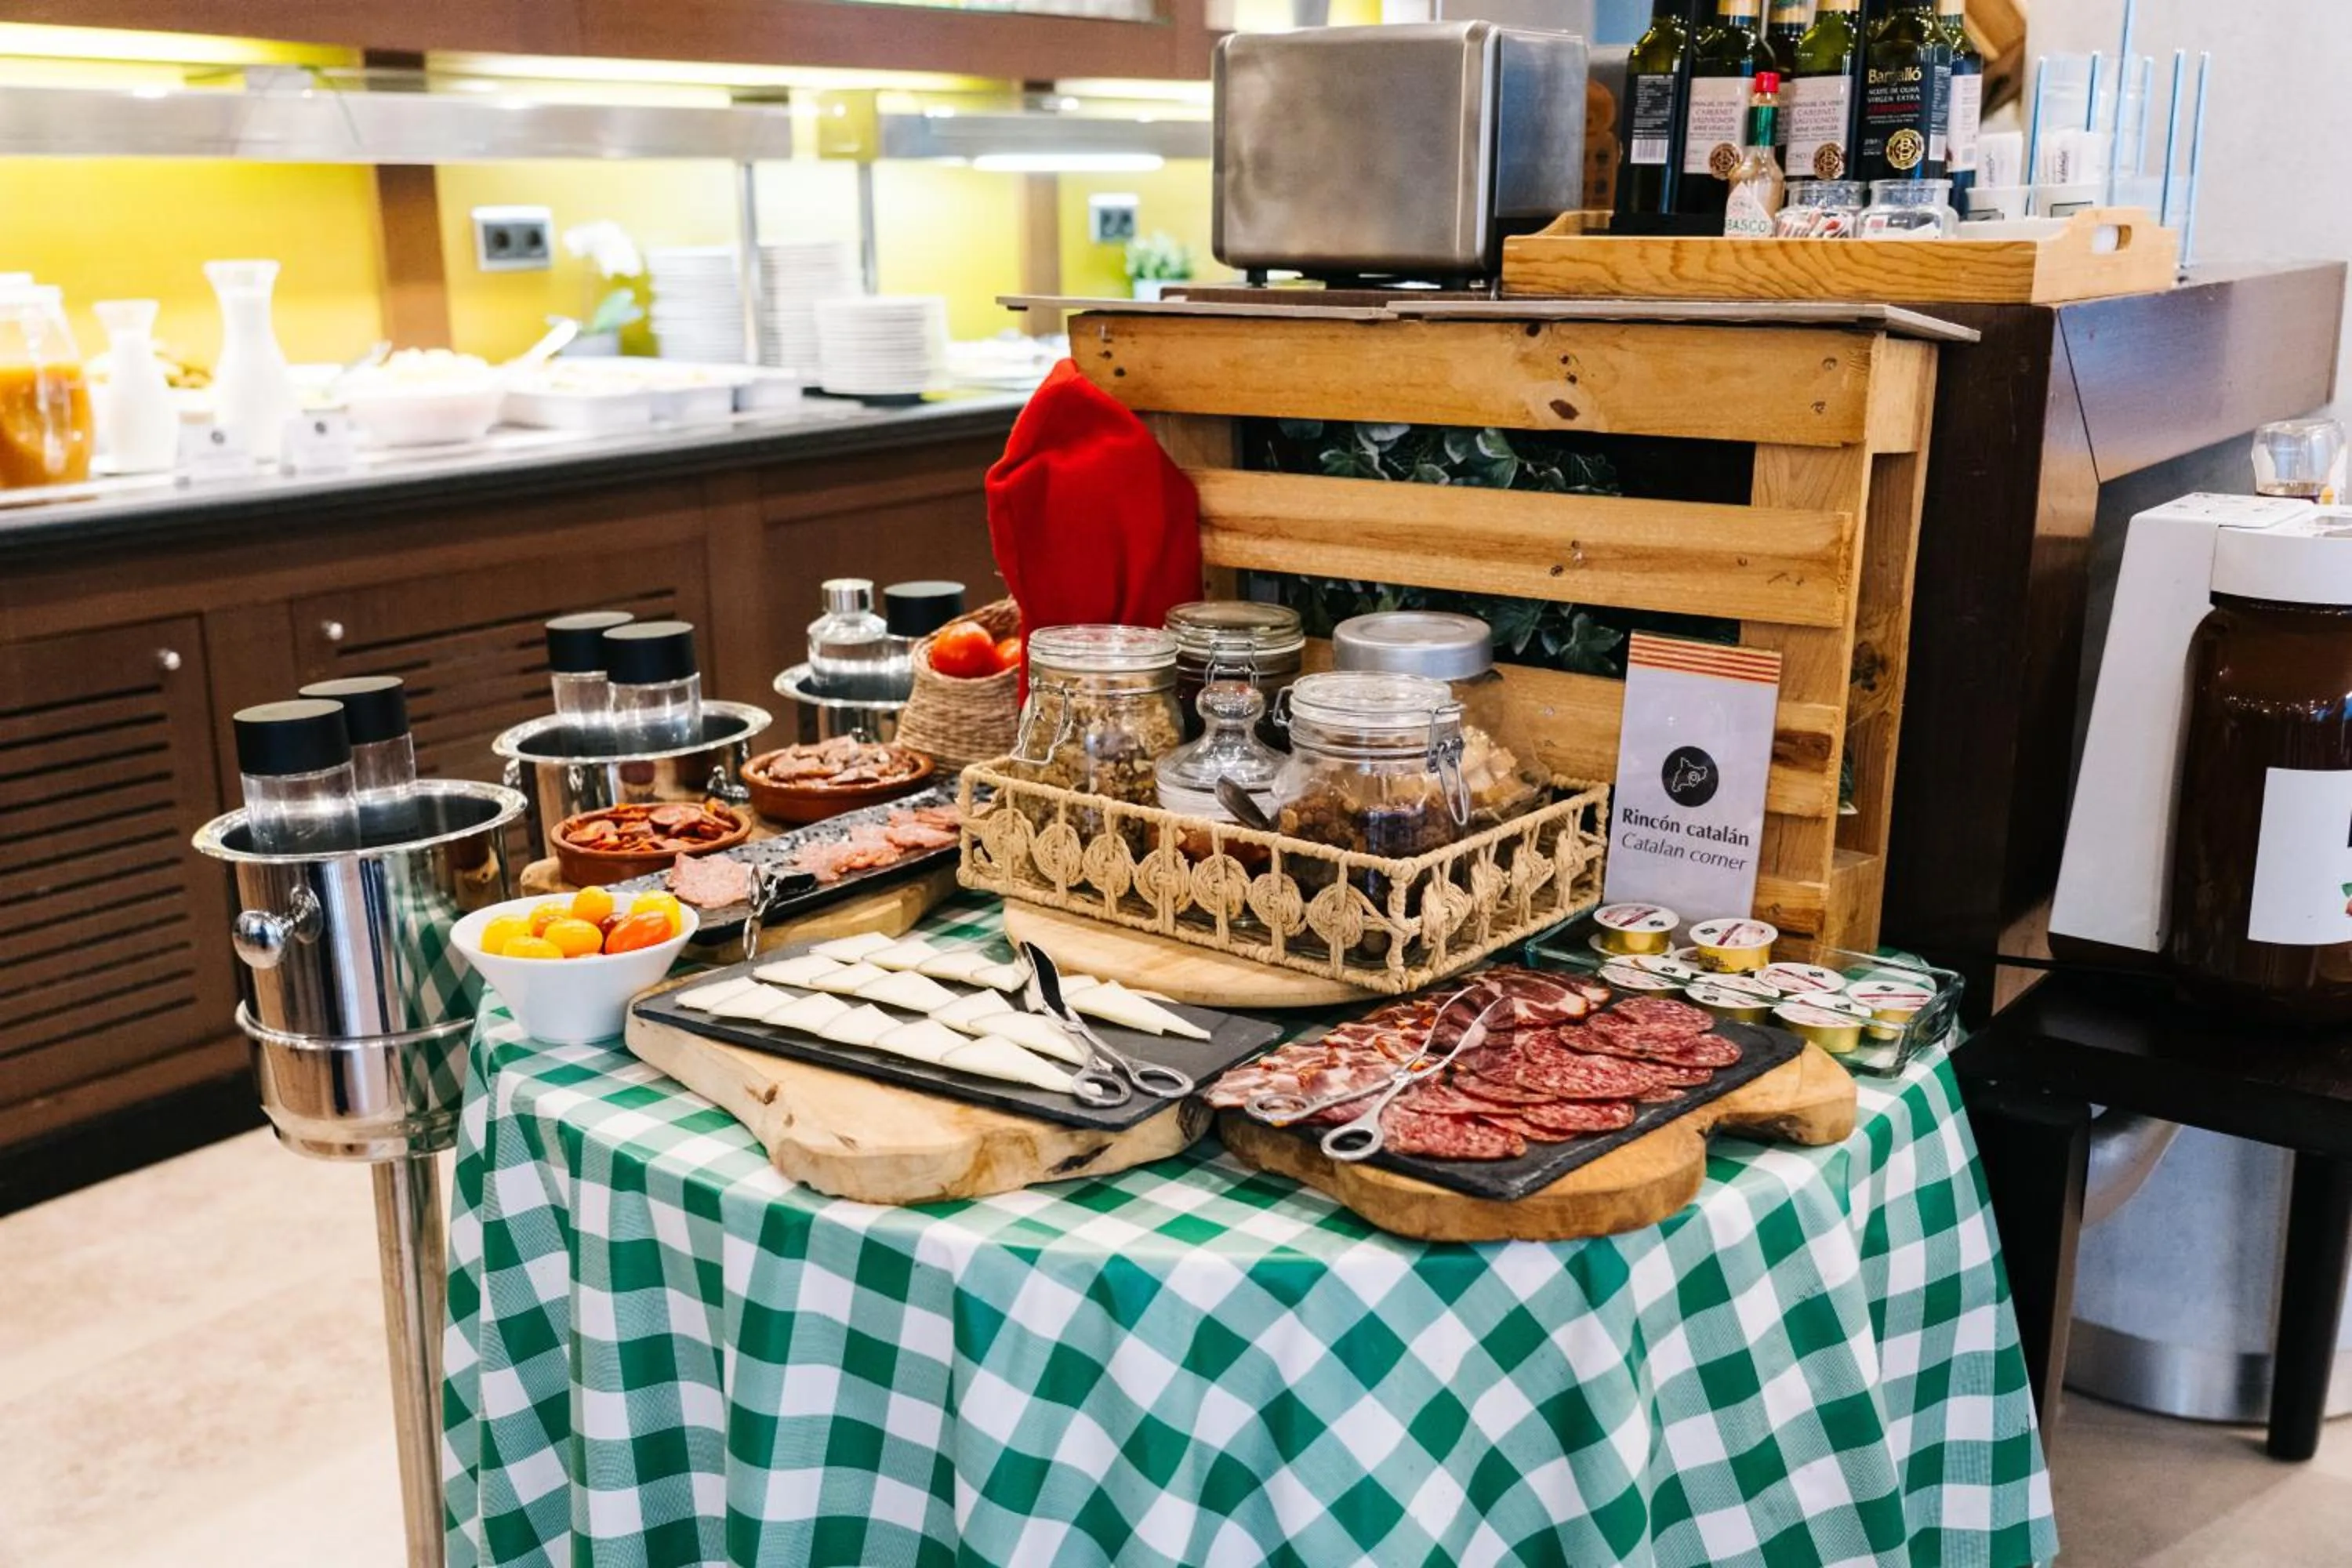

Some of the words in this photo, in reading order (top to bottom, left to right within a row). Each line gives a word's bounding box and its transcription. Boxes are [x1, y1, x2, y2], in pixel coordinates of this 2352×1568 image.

[1622, 808, 1681, 833] Rincón
[1686, 825, 1749, 847] catalán
[1621, 832, 1685, 858] Catalan
[1690, 850, 1748, 871] corner
